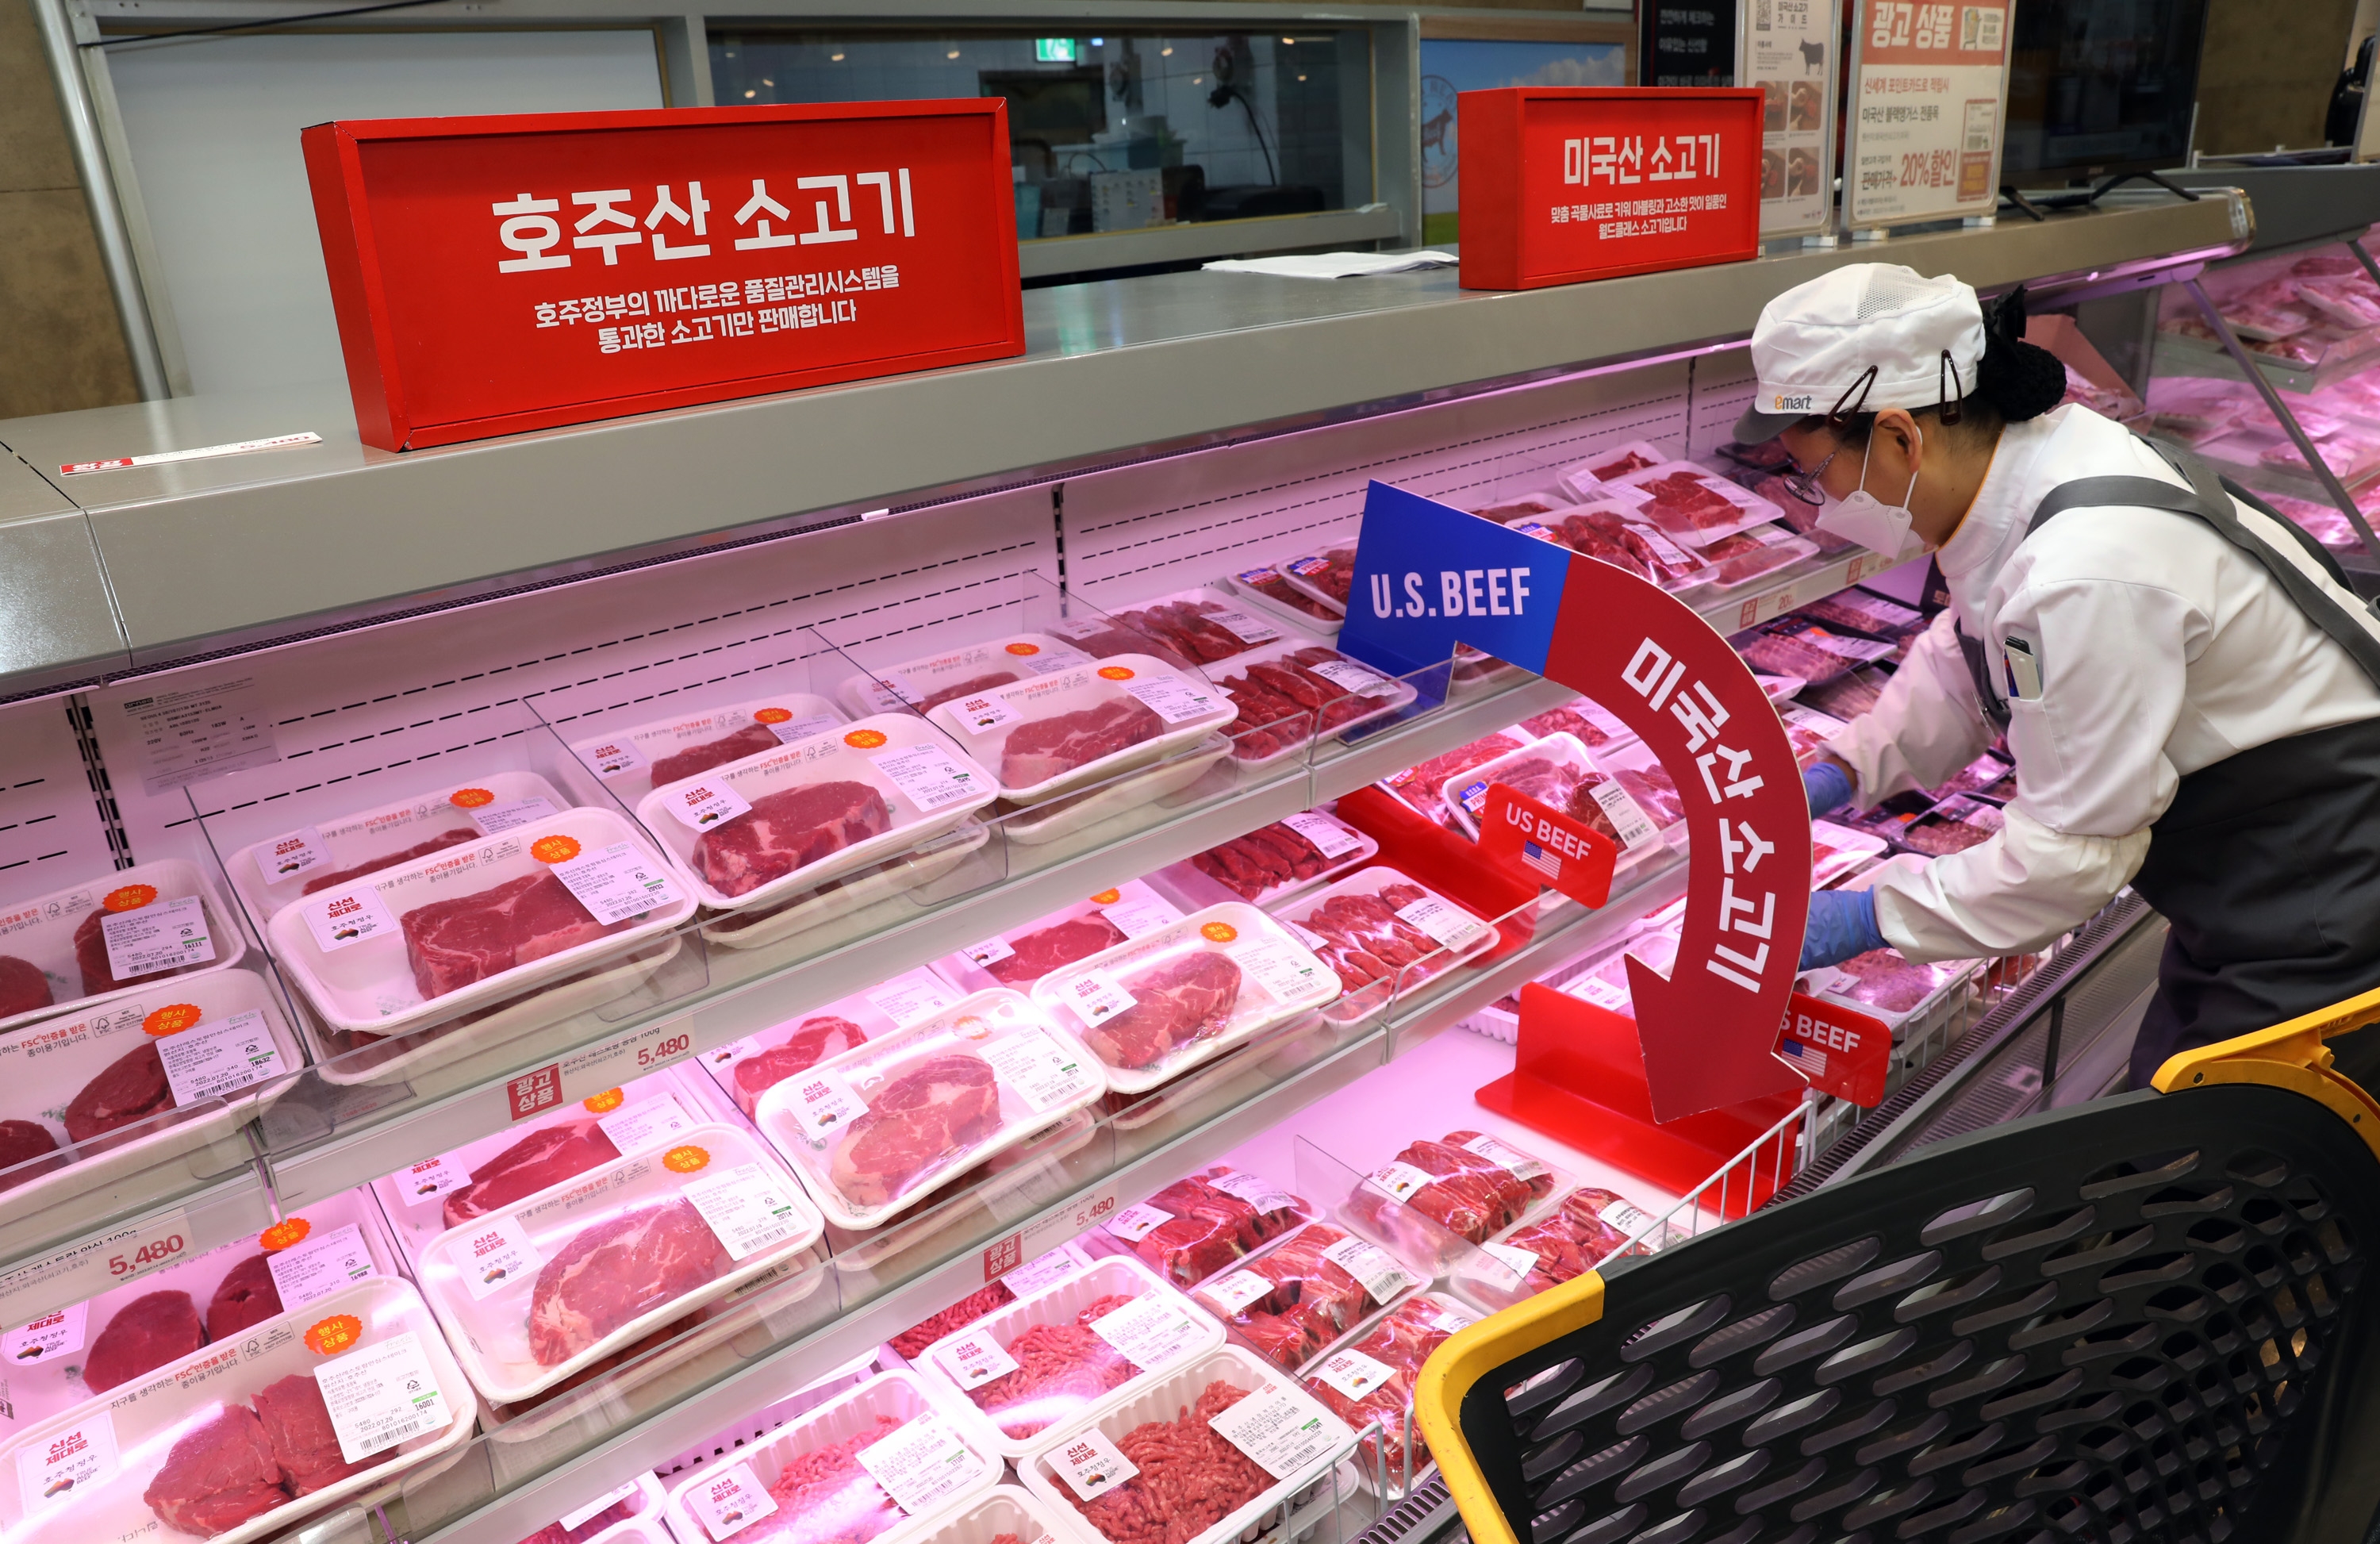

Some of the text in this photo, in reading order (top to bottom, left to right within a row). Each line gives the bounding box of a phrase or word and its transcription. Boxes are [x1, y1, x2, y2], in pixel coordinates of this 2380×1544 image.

[1872, 2, 1914, 48] 광고
[1916, 5, 1954, 49] 상품
[1865, 78, 1886, 94] 신세계
[1888, 78, 1928, 94] 포인트카드로
[1863, 106, 1939, 123] 미국산 블랙앵거스 전품목
[1564, 133, 1719, 186] 미국산 소고기
[1552, 194, 1726, 224] 맞춤 곡물사료로 키워 마블링과 고소한 맛이 일품인
[492, 168, 916, 274] 호주산 소고기
[1599, 217, 1687, 240] 월드클래스 소고기입니다
[535, 264, 899, 328] 호주정부의 까다로운 품질관리시스템을
[598, 302, 857, 354] 통과한 소고기만 판매합니다
[1775, 395, 1812, 409] emart
[965, 699, 984, 708] 신선
[967, 703, 992, 712] 제대로
[1621, 637, 1764, 804] 미국산
[595, 745, 615, 754] 신선
[596, 748, 622, 759] 제대로
[736, 765, 759, 778] 생각하는
[685, 787, 708, 800] 신선
[686, 792, 715, 807] 제대로
[1506, 802, 1591, 861] US BEEF
[274, 843, 306, 856] 제대로
[275, 838, 300, 849] 신선
[540, 839, 562, 851] 행사
[549, 847, 571, 858] 상품
[397, 853, 475, 885] 생각하는 받은
[429, 863, 478, 884] 종이용기입니다.
[119, 889, 142, 898] 행사
[647, 884, 664, 893] 20933
[118, 897, 142, 907] 상품
[327, 897, 355, 912] 신선
[606, 896, 632, 907] 2022.07.20
[1706, 818, 1775, 993] 소고기
[22, 908, 39, 919] 받은
[328, 905, 363, 920] 제대로
[0, 917, 43, 936] 용기입니다.
[331, 914, 374, 931] 호주청정우
[132, 951, 163, 961] 2022.07.20
[161, 1008, 186, 1020] 행사
[70, 1024, 86, 1034] 받은
[158, 1020, 183, 1030] 상품
[1796, 1014, 1861, 1054] BEEF
[26, 1033, 90, 1058] 종이용기입니다.
[637, 1034, 689, 1066] 5,480
[251, 1057, 271, 1067] 18632
[195, 1072, 228, 1086] 2022.07.20
[217, 1065, 263, 1083] 801016200174
[516, 1069, 552, 1097] 광고
[802, 1081, 823, 1096] 신선
[518, 1085, 554, 1112] 상품
[805, 1086, 832, 1104] 제대로
[672, 1150, 693, 1161] 행사
[679, 1158, 701, 1169] 상품
[412, 1159, 442, 1174] 제대로
[535, 1177, 608, 1214] 생각하는 받은
[777, 1212, 793, 1220] 20714
[1076, 1196, 1115, 1227] 5,480
[271, 1223, 294, 1236] 행사
[277, 1231, 298, 1244] 상품
[473, 1231, 498, 1248] 신선
[109, 1235, 183, 1276] 5,480
[474, 1239, 507, 1258] 제대로
[990, 1238, 1015, 1259] 광고
[990, 1250, 1016, 1275] 상품
[351, 1270, 368, 1281] 16988
[303, 1287, 332, 1302] 2022.07.20
[27, 1313, 65, 1332] 제대로
[317, 1321, 344, 1337] 행사
[19, 1330, 68, 1348] 호주청정우
[322, 1332, 349, 1349] 상품
[955, 1342, 976, 1354] 신선
[958, 1347, 985, 1362] 제대로
[1328, 1357, 1346, 1369] 신선
[1334, 1359, 1354, 1374] 제대로
[110, 1347, 237, 1409] 지구를 생각하는 받은
[181, 1358, 241, 1389] 종이용기입니다.
[415, 1399, 434, 1411] 16001
[355, 1419, 370, 1428] 5480
[360, 1416, 393, 1433] 2022.07.20
[382, 1409, 428, 1431] 801016200174
[1310, 1422, 1323, 1433] 17049
[49, 1431, 83, 1454] 신선
[1066, 1442, 1088, 1458] 신선
[45, 1440, 89, 1466] 제대로
[950, 1454, 965, 1466] 17107
[1070, 1449, 1099, 1465] 제대로
[43, 1454, 98, 1484] 호주청정우
[1077, 1456, 1112, 1478] 호주청정우
[710, 1478, 732, 1493] 신선
[712, 1485, 742, 1503] 제대로
